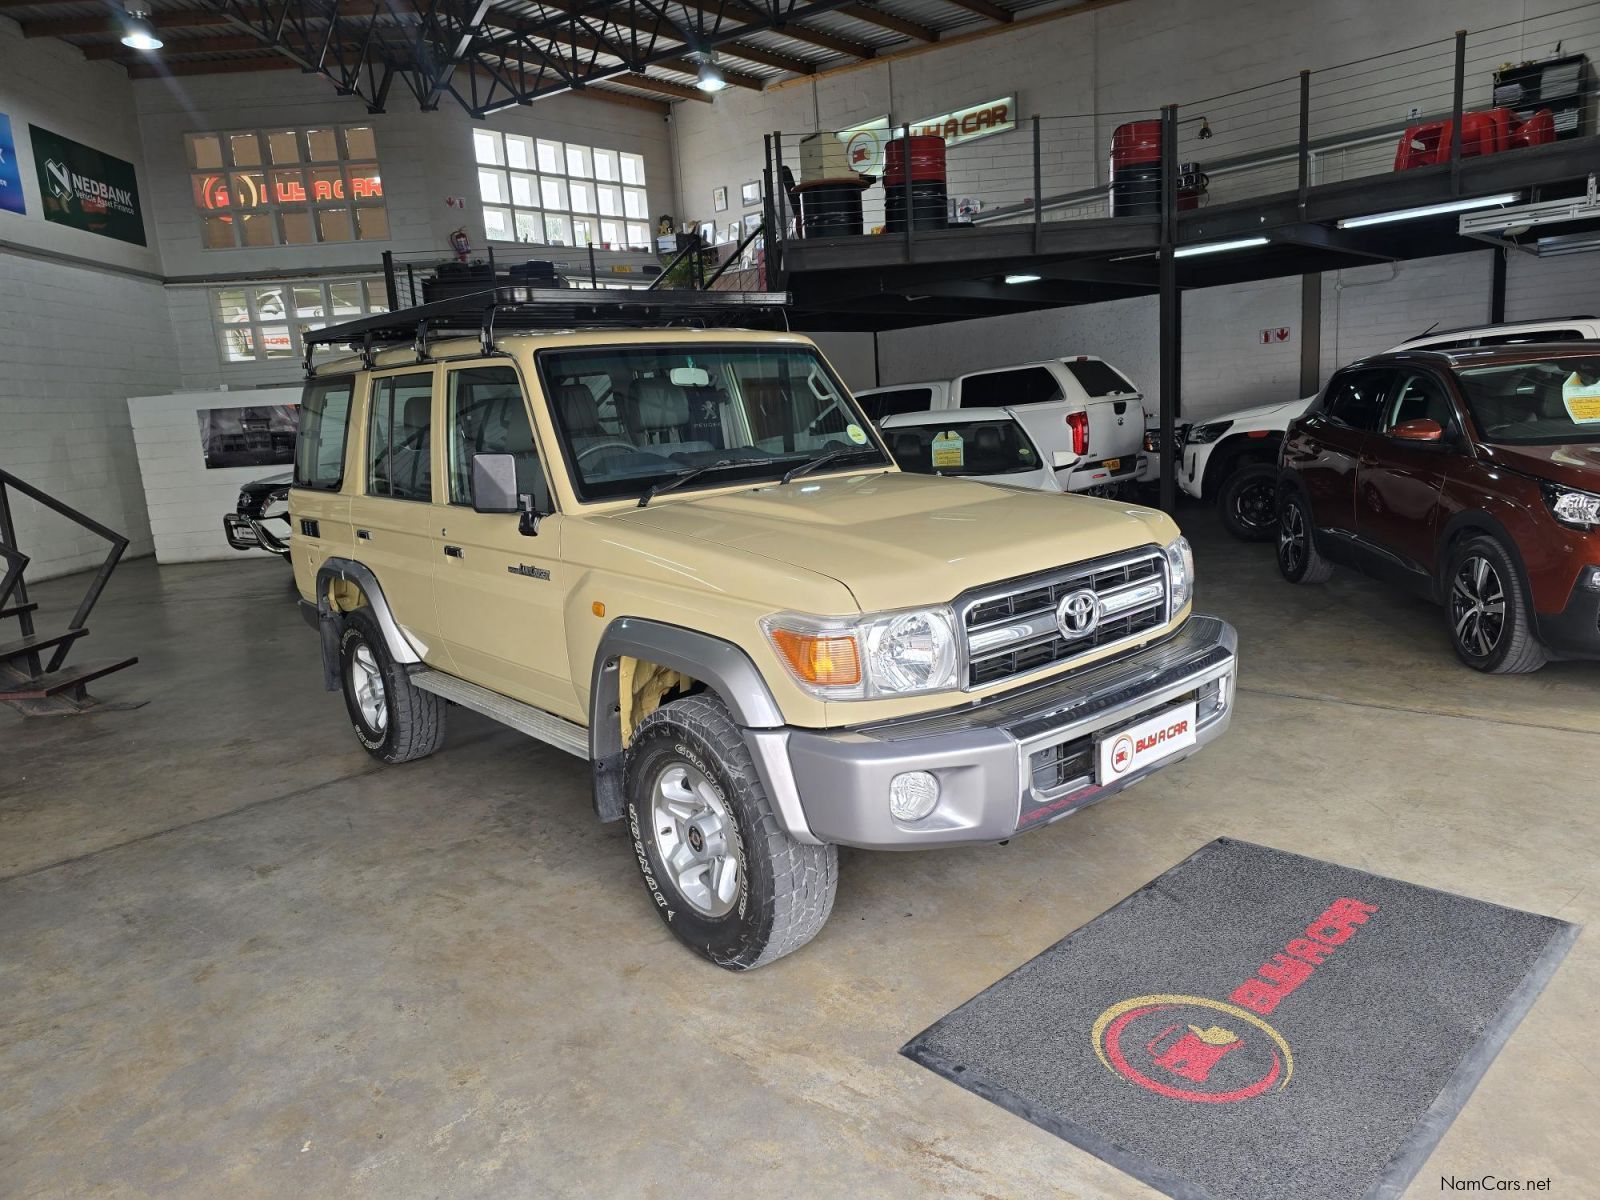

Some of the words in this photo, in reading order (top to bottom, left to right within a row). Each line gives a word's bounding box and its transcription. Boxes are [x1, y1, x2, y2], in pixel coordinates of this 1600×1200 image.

[943, 118, 959, 140] A
[962, 104, 1008, 134] CAR
[72, 172, 133, 207] NEDBANK
[74, 189, 97, 203] Vehicle
[113, 201, 135, 215] Finance
[313, 180, 332, 202] A
[333, 177, 383, 199] CAR
[1135, 733, 1157, 754] BUY
[1158, 730, 1166, 744] A
[1166, 720, 1188, 739] CAR
[629, 803, 668, 907] DUNLOP
[1304, 896, 1380, 946] CAR
[1285, 938, 1335, 966] A
[1227, 952, 1315, 1016] BUY
